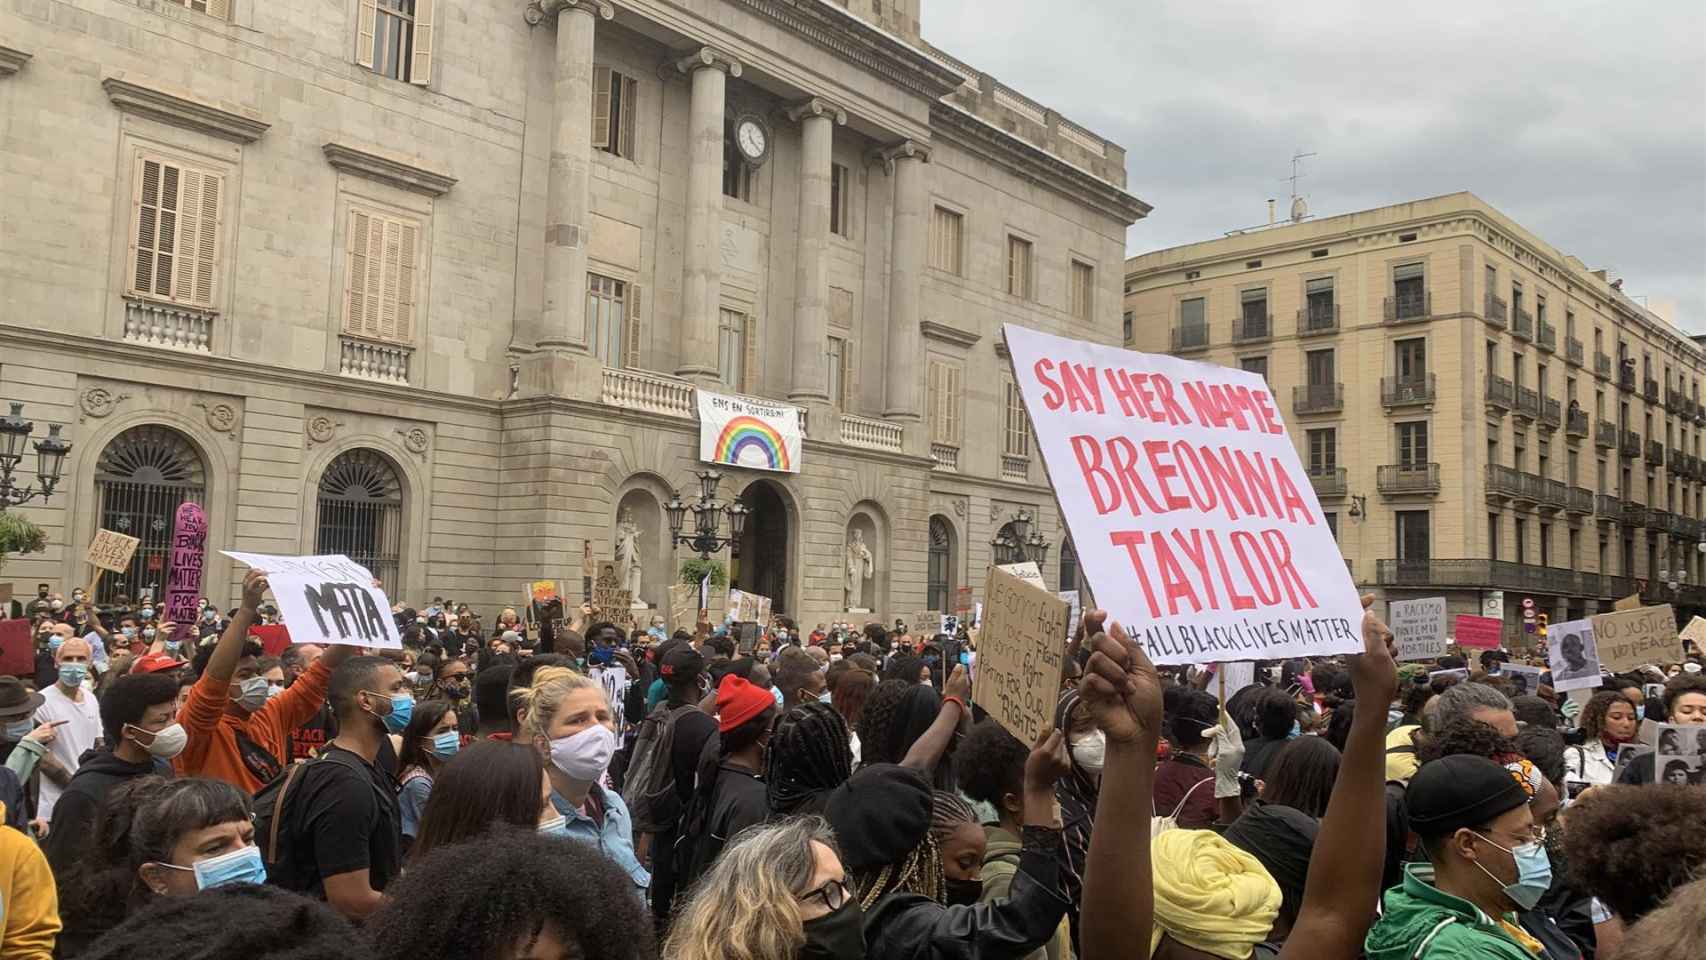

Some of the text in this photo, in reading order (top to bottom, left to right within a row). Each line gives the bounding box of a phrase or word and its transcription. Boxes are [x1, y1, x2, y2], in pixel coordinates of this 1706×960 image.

[712, 398, 729, 411] ENS
[732, 402, 743, 413] EN
[1034, 358, 1284, 436] SAY HER NAME
[1070, 434, 1316, 526] BREONNA
[93, 543, 126, 559] LIVES
[99, 531, 134, 552] BLACK
[88, 552, 127, 569] MATTER
[174, 553, 203, 567] LIVES
[1110, 527, 1319, 619] TAYLOR
[168, 567, 202, 590] MATTER
[173, 595, 195, 607] POC
[304, 582, 390, 641] MATA
[1594, 621, 1616, 638] NO
[1625, 612, 1675, 637] JUSTICE
[1630, 631, 1681, 657] PEACE
[1001, 695, 1038, 742] RIGHTS
[1024, 691, 1045, 722] OUR
